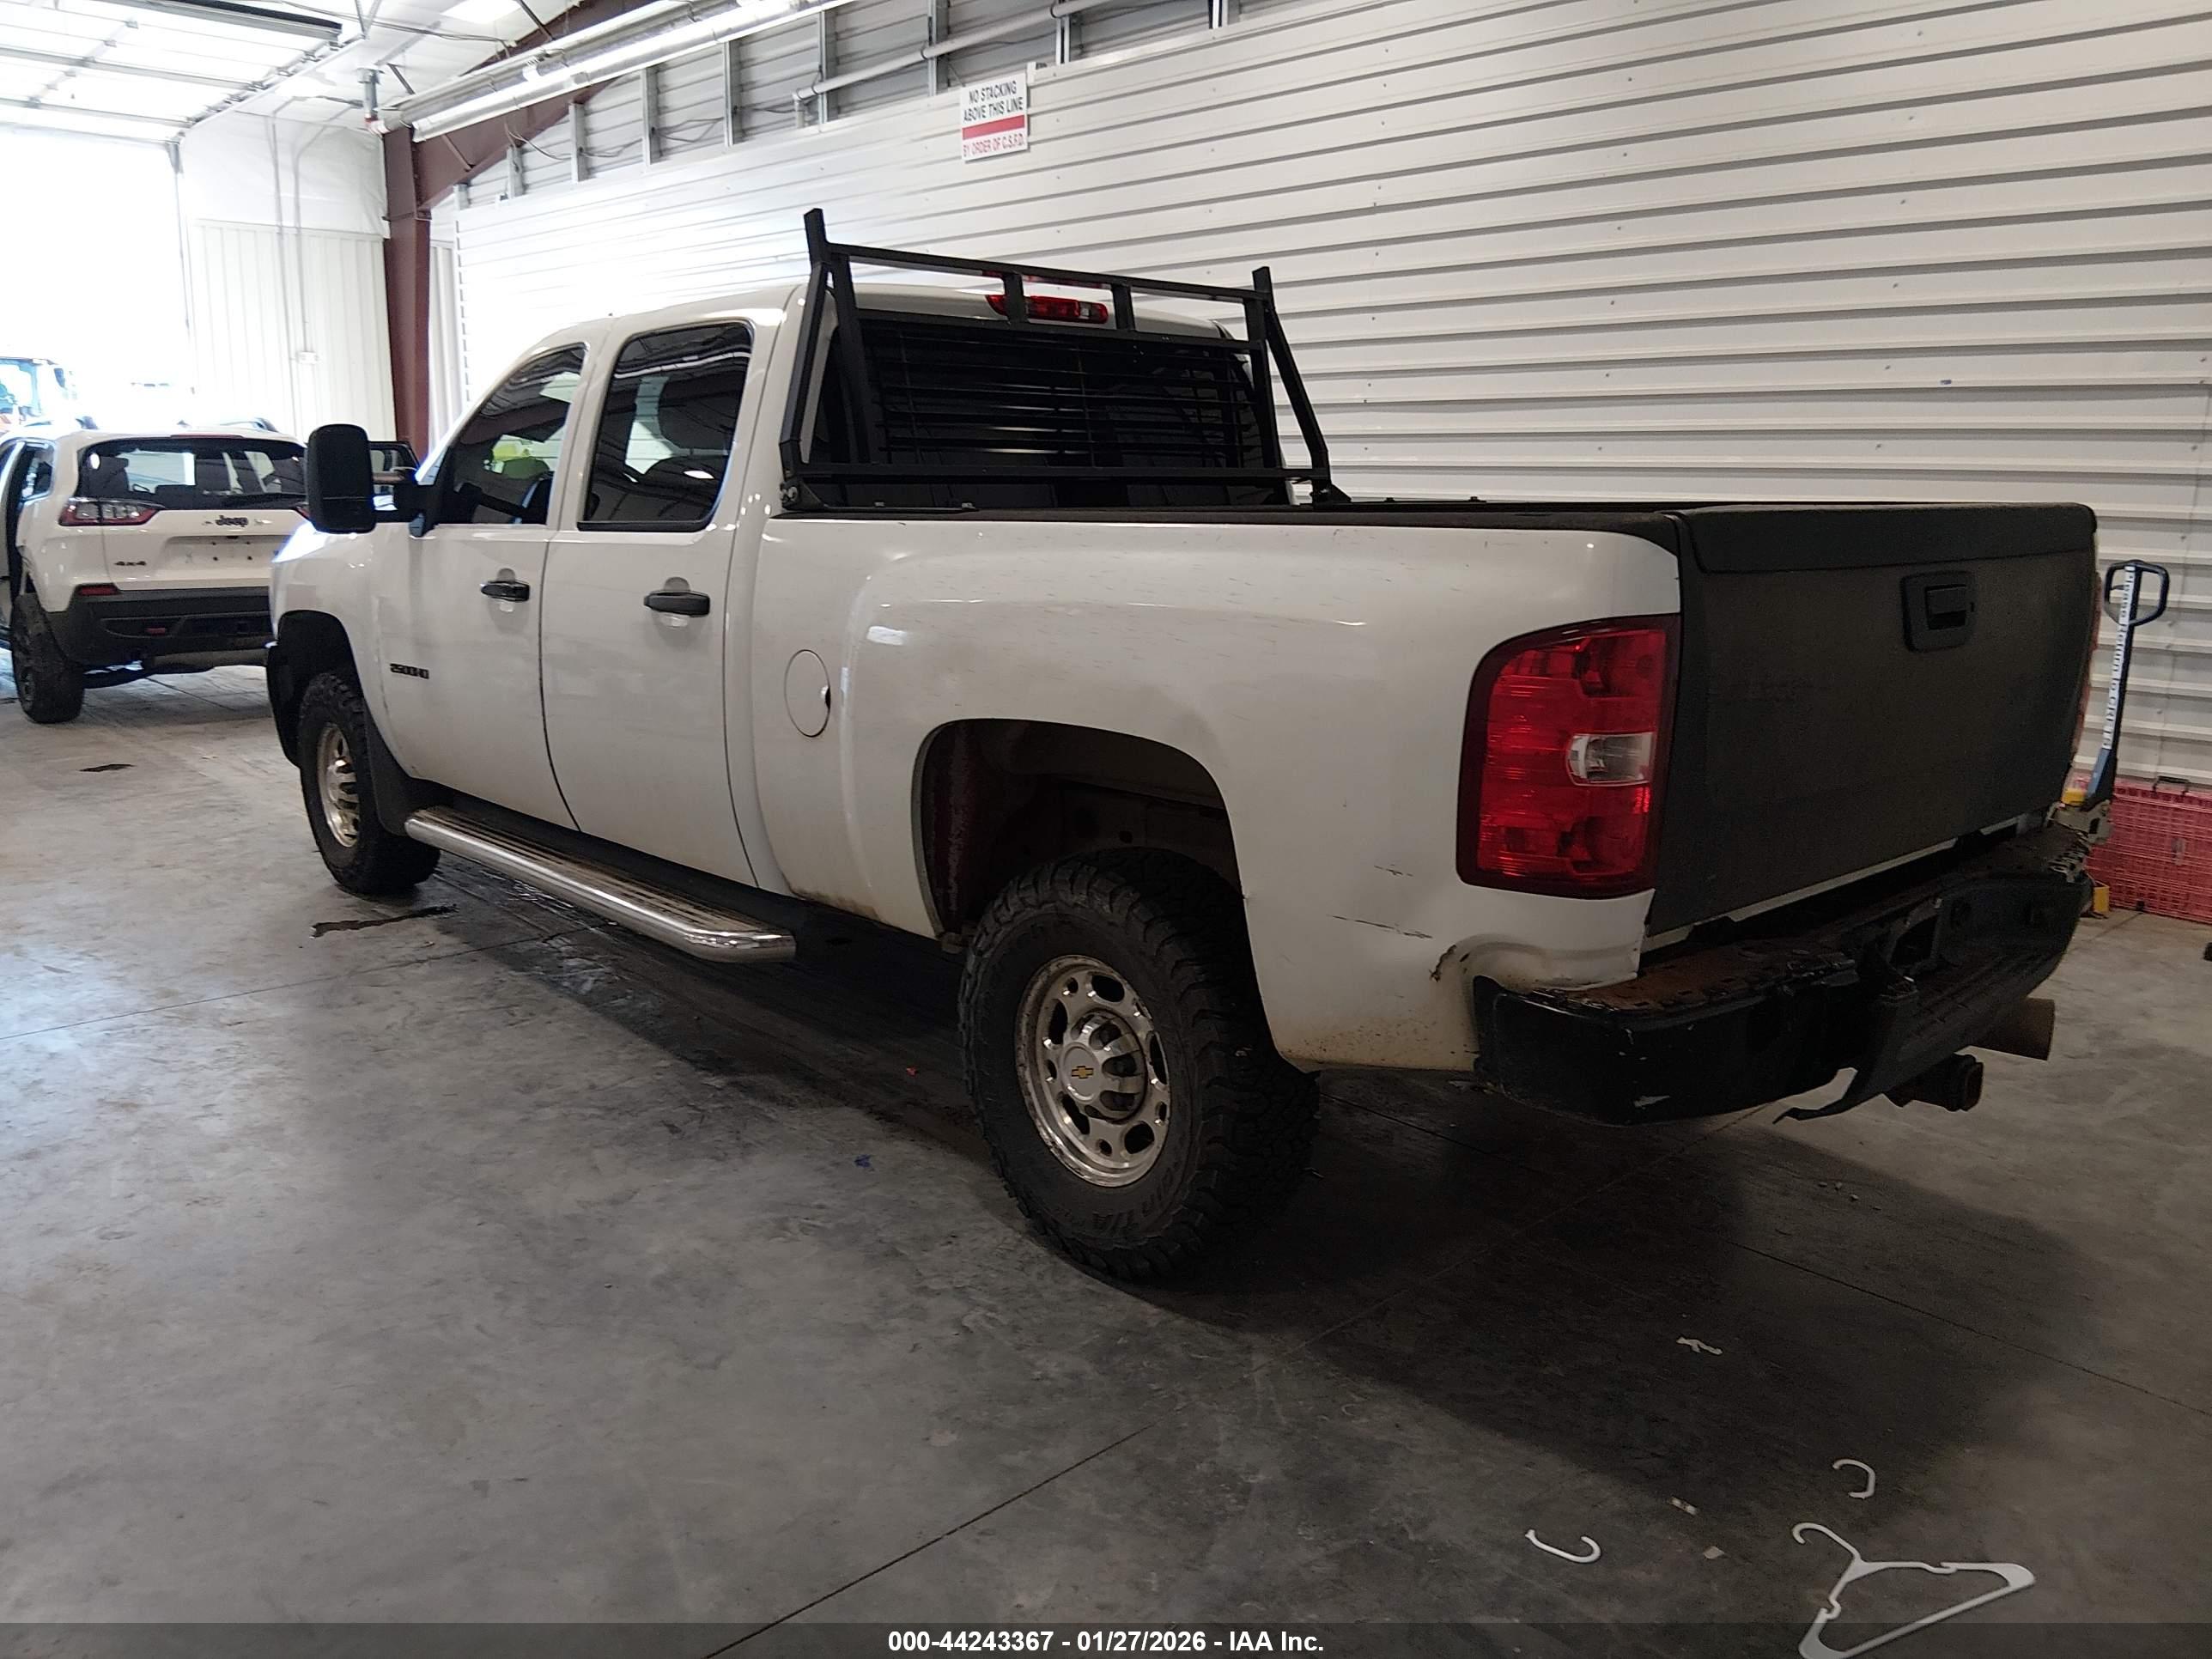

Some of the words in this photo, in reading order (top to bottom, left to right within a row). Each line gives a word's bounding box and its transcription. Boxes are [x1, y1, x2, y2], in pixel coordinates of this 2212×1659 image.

[969, 89, 979, 104] NO
[981, 81, 1017, 101] STACKING
[963, 105, 987, 122] ABOVE
[988, 100, 1005, 117] THIS
[1006, 97, 1024, 112] LINE
[963, 144, 970, 157] BY
[972, 139, 992, 155] ORDER
[993, 137, 1001, 152] OF
[216, 514, 248, 527] Jeep
